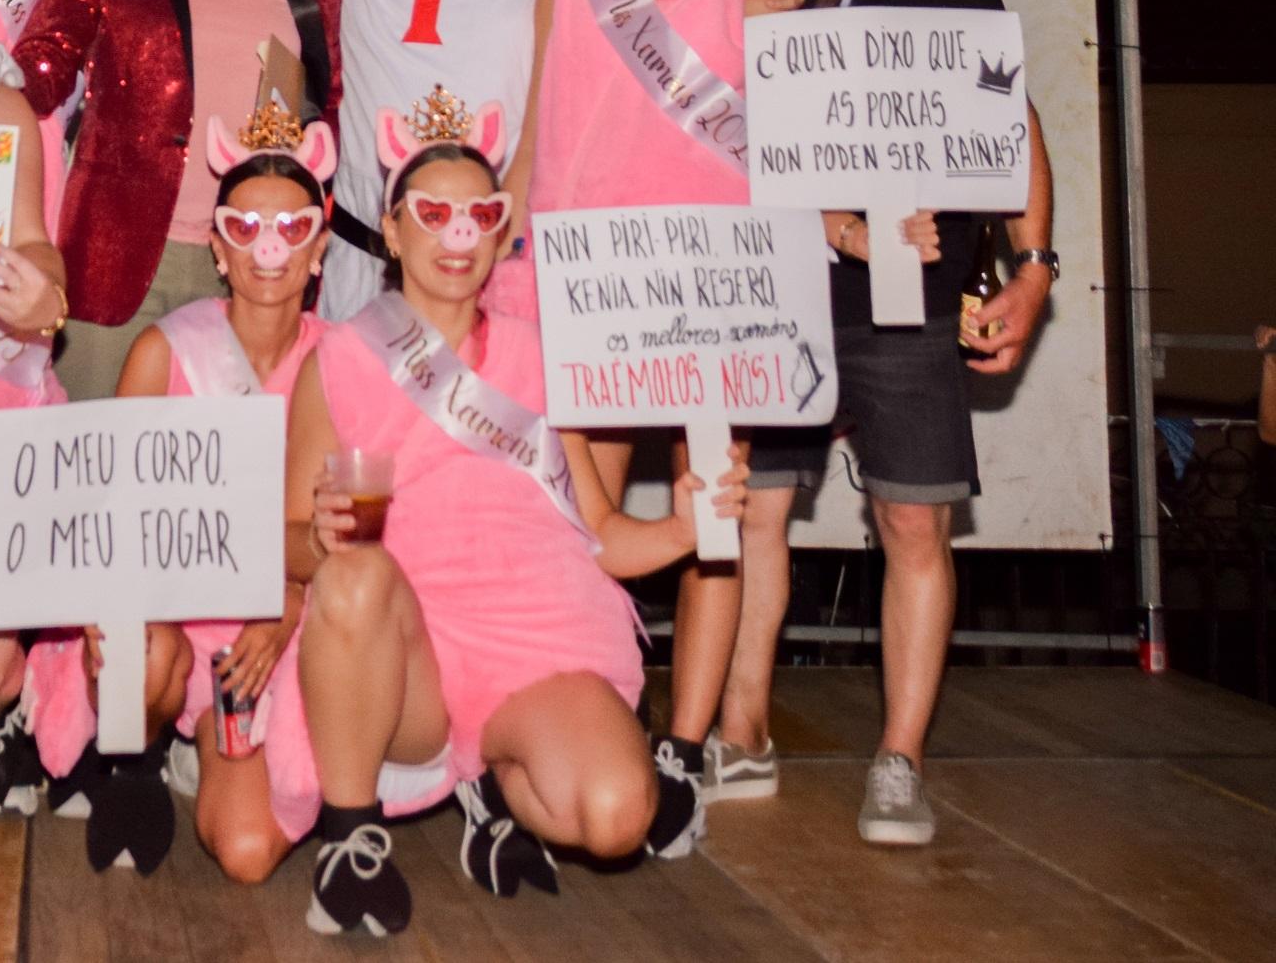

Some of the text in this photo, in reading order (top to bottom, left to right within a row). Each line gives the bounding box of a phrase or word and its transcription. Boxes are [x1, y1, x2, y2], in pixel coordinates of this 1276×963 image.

[865, 25, 915, 71] DIXO
[928, 29, 968, 71] QUE
[826, 90, 947, 129] AS PORCAS
[760, 142, 802, 176] NON
[813, 142, 878, 173] PODEN
[887, 140, 932, 173] SER
[543, 221, 592, 265] NIN
[732, 216, 775, 257] NIN
[644, 267, 684, 310] NIN
[385, 318, 436, 390] Miss
[606, 334, 629, 352] os
[640, 313, 721, 349] mellores
[13, 442, 36, 498] O
[53, 432, 115, 491] MEU
[6, 507, 239, 574] O MEU FOGAR
